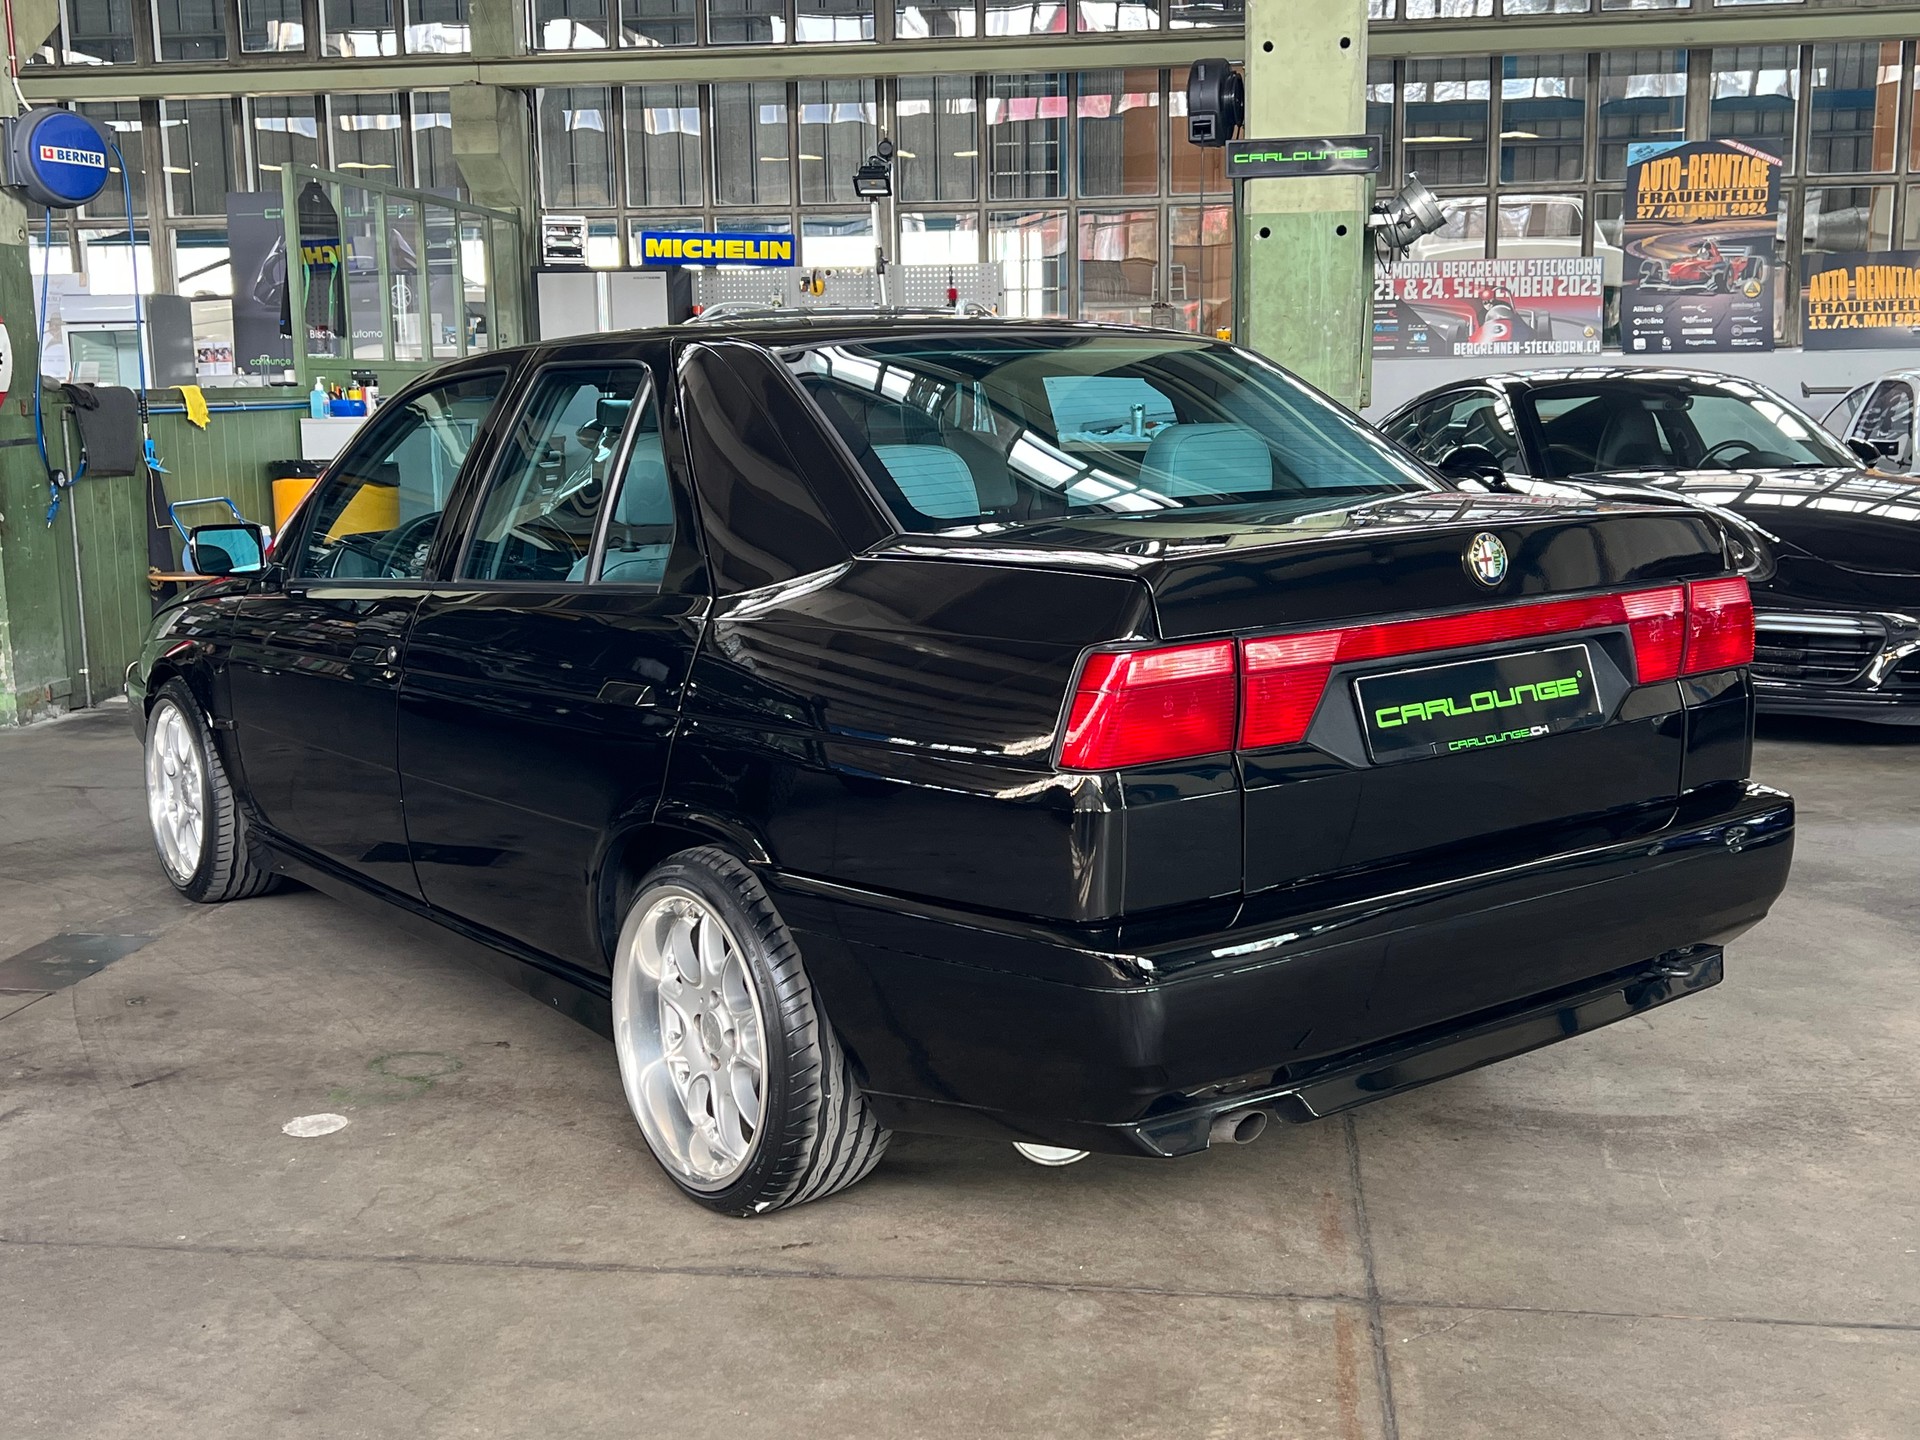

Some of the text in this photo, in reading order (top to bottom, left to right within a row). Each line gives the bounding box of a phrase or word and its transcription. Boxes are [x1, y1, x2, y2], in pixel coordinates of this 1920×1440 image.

[57, 149, 102, 165] BERNER
[1233, 149, 1368, 164] CARLOUNGE
[1638, 153, 1770, 191] AUTO-RENNTAGE
[1639, 189, 1767, 204] FRAUENFELD
[1730, 202, 1767, 216] 2024
[645, 238, 791, 260] MICHELIN
[1442, 259, 1525, 279] BERGRENNEN
[1527, 258, 1602, 277] STECKBORN
[1374, 279, 1400, 301] 23.
[1403, 278, 1418, 300] &
[1422, 277, 1450, 300] 24.
[1557, 274, 1602, 297] 2023
[1632, 305, 1655, 313] Allianz
[1810, 299, 1920, 314] FRAUENFEL
[1453, 340, 1600, 356] BERGRENNEN-STECKBORN.CH
[1375, 677, 1580, 729] CARLOUNGE
[1448, 724, 1549, 751] CARLOUNGE.CH
